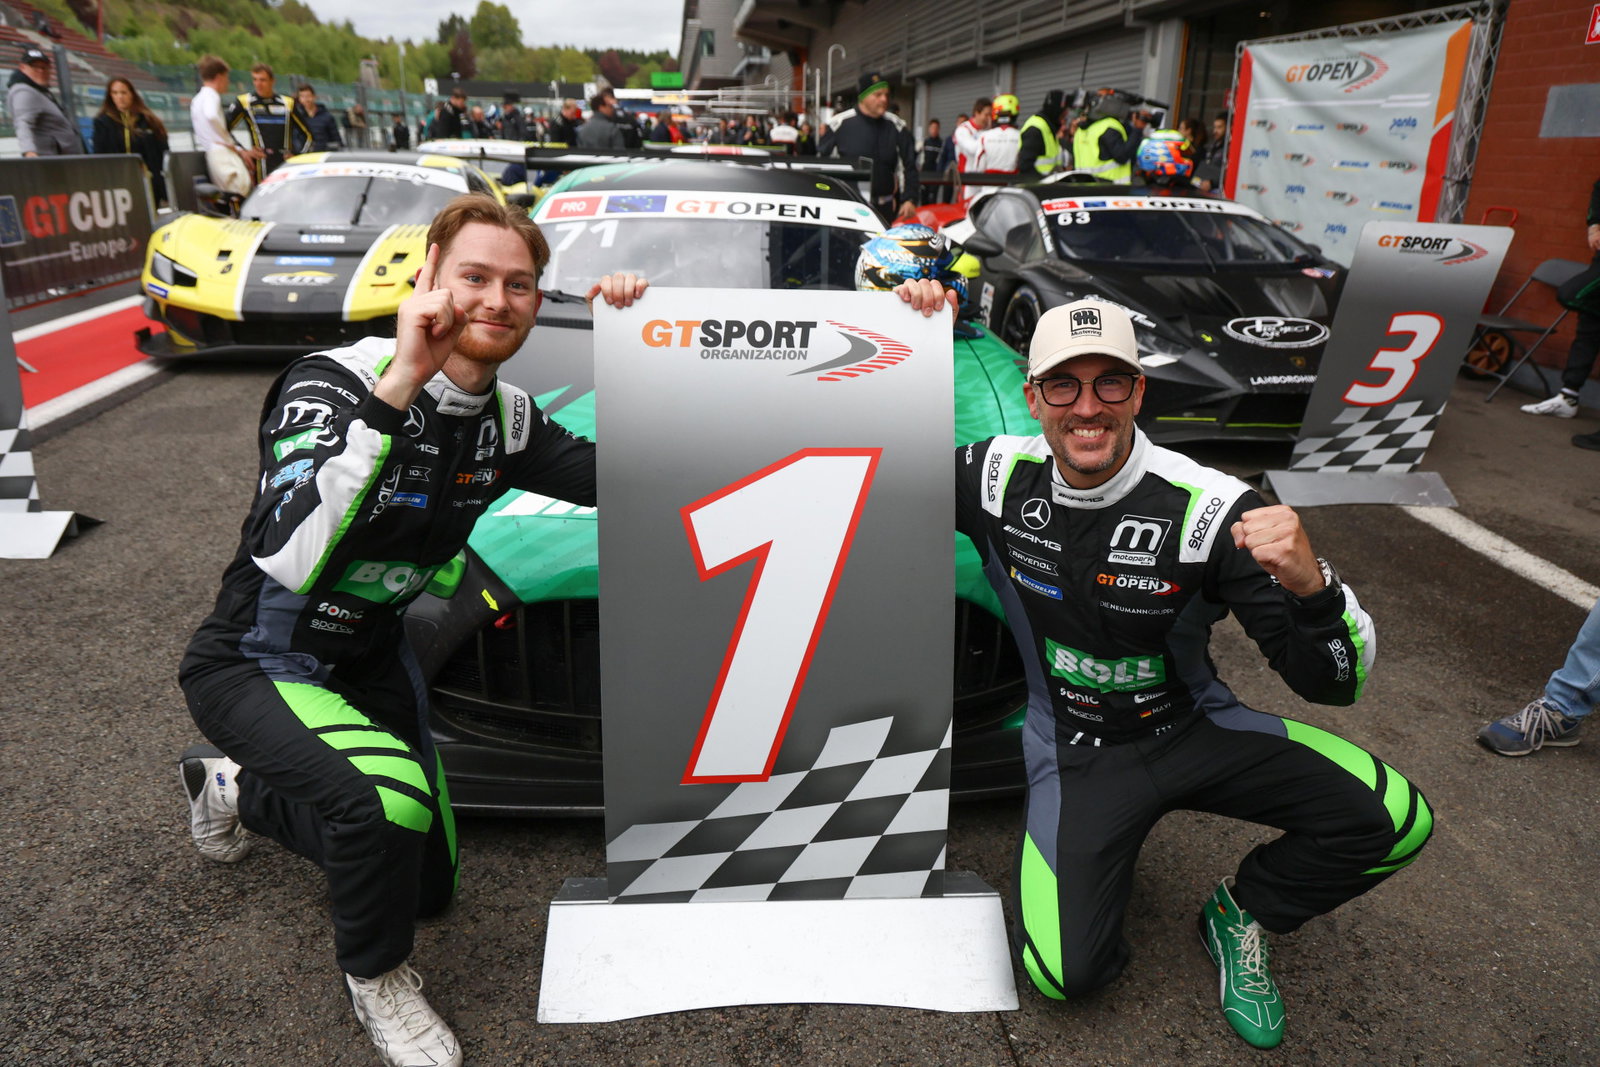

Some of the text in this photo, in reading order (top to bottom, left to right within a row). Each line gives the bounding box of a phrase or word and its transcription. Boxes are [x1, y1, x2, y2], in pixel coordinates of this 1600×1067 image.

[561, 200, 587, 213] PRO
[1057, 211, 1091, 226] 63
[554, 220, 620, 252] 71
[69, 237, 128, 262] Europe
[700, 349, 808, 361] ORGANIZACION
[1342, 311, 1446, 407] 3
[511, 394, 526, 442] sparco
[987, 453, 1003, 503] sparco
[1187, 497, 1222, 552] sparco
[1019, 532, 1062, 552] AMG
[1012, 550, 1053, 572] RAVENOL
[1112, 553, 1154, 563] motopark
[1022, 577, 1059, 596] MICHELIN
[310, 619, 355, 633] sparco
[680, 447, 883, 785] 1
[1054, 647, 1158, 684] BOLL
